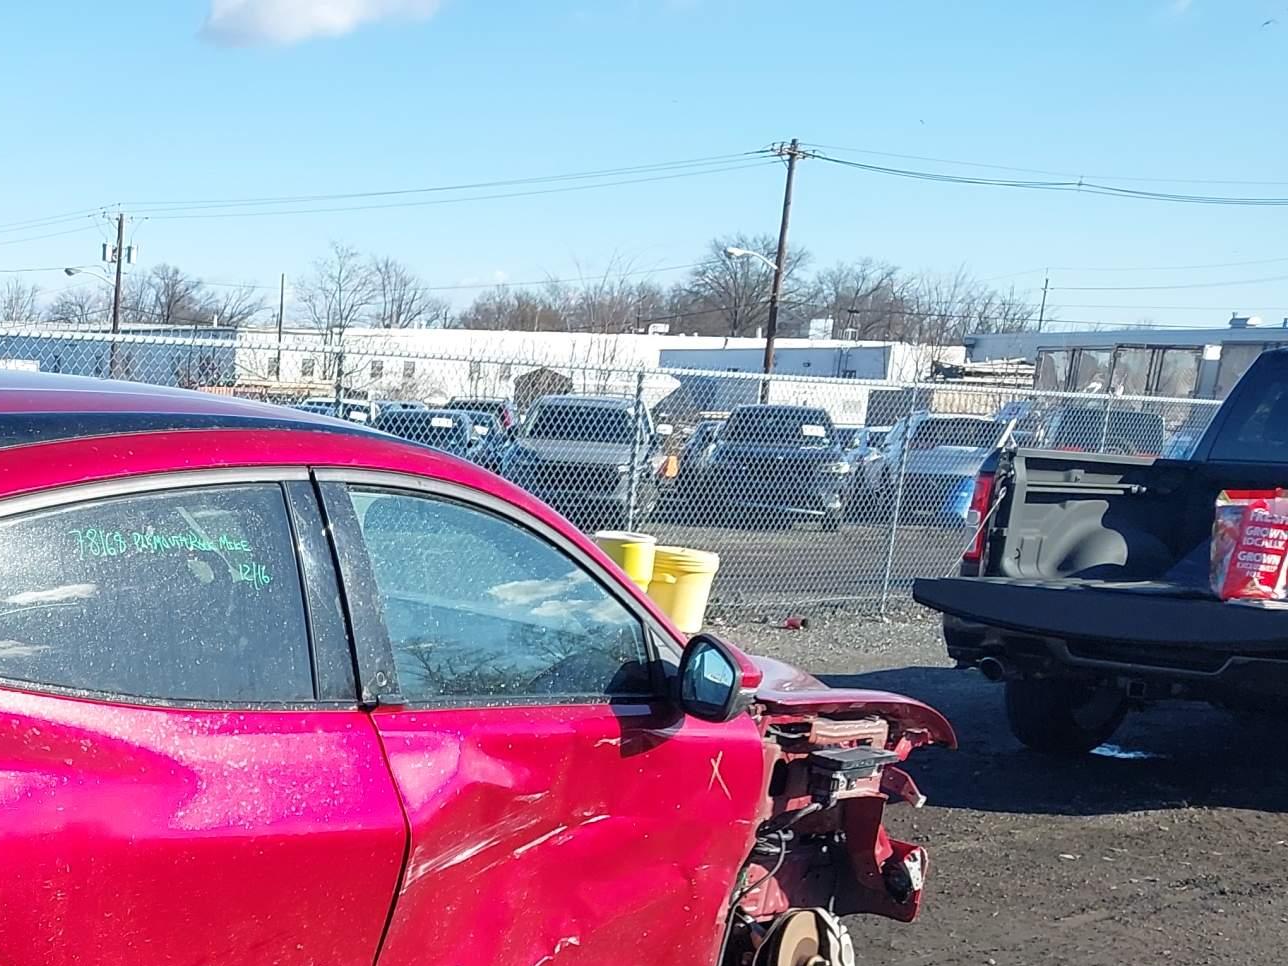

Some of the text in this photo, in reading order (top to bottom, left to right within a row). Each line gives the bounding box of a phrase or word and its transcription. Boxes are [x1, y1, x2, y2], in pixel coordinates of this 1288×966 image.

[1246, 526, 1288, 540] GROWN
[1237, 551, 1282, 566] GROWN
[239, 561, 270, 590] 12/16
